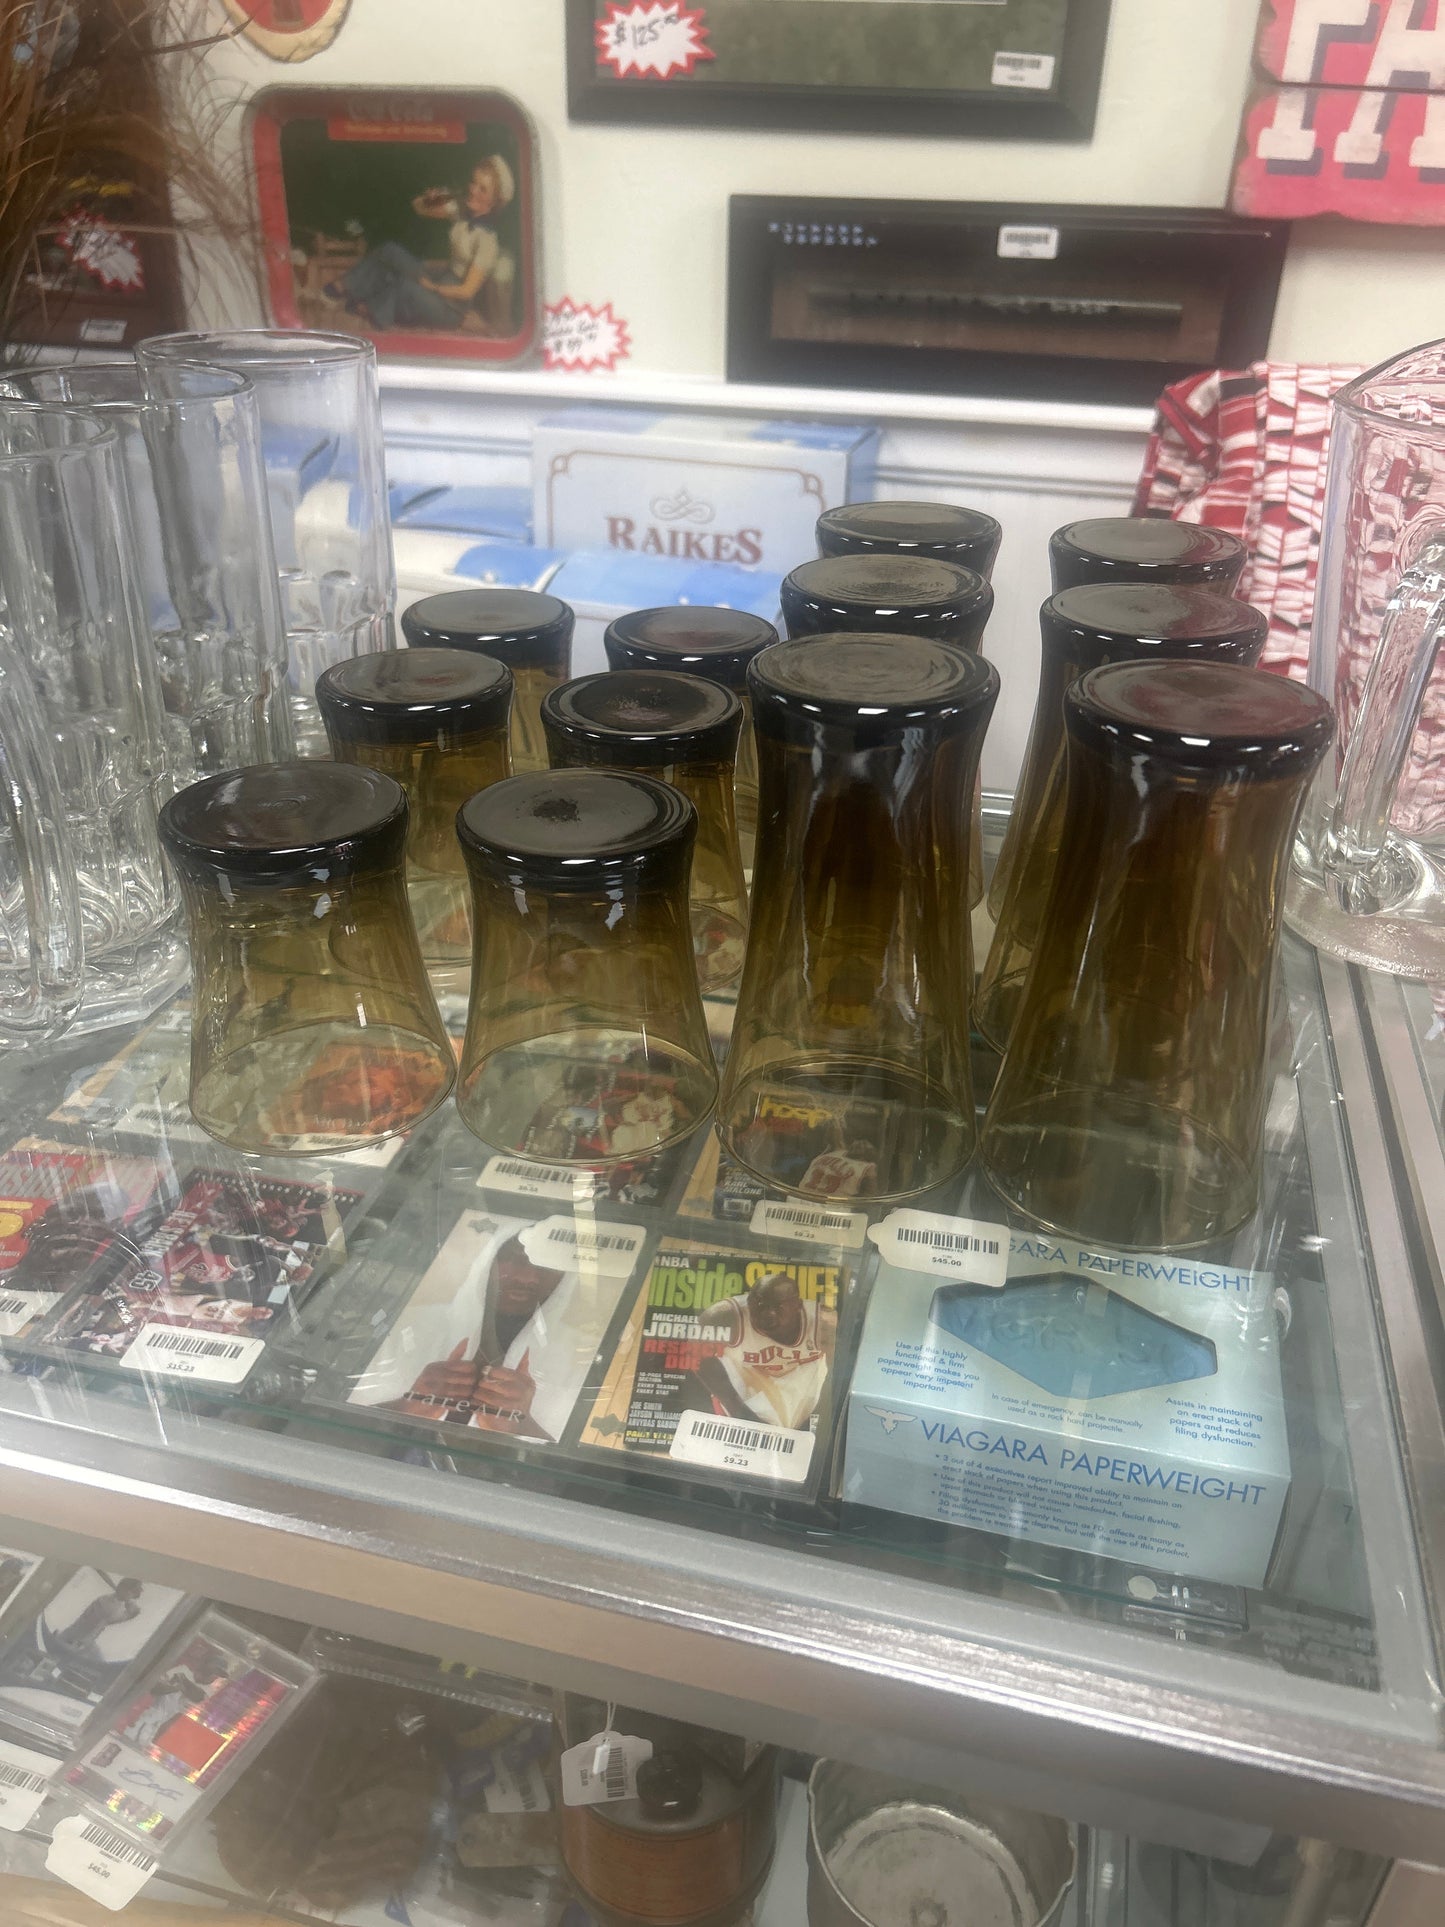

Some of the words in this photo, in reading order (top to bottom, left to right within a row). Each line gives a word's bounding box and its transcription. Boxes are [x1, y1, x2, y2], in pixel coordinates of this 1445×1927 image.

[606, 515, 764, 565] RAIKES
[722, 1187, 763, 1195] MALONE
[660, 1255, 690, 1268] NBA
[932, 1256, 962, 1267] $45.00
[1077, 1250, 1256, 1293] PAPERWEIGHT
[647, 1258, 744, 1311] inside
[652, 1312, 699, 1324] MICHAEL
[643, 1321, 731, 1342] JORDAN
[664, 1352, 700, 1370] DUE
[895, 1350, 937, 1363] functional
[948, 1359, 965, 1369] firm
[896, 1341, 912, 1350] Use
[914, 1344, 923, 1352] of
[925, 1347, 940, 1355] this
[942, 1348, 968, 1361] highly
[877, 1356, 932, 1371] paperweight
[934, 1367, 961, 1377] makes
[964, 1373, 980, 1382] you
[881, 1366, 912, 1377] appear
[915, 1373, 934, 1382] very
[903, 1379, 947, 1393] important.
[991, 1392, 999, 1401] In
[1000, 1395, 1020, 1405] case
[1022, 1398, 1030, 1407] of
[1078, 1411, 1094, 1419] can
[1095, 1413, 1106, 1421] be
[1108, 1416, 1144, 1430] manually
[1007, 1405, 1026, 1414] used
[1028, 1409, 1037, 1417] as
[1048, 1413, 1064, 1422] rock
[1066, 1416, 1085, 1426] hard
[1165, 1397, 1195, 1409] Assists
[1197, 1402, 1207, 1411] in
[1209, 1405, 1263, 1423] maintaining
[1191, 1412, 1214, 1421] erect
[1217, 1415, 1241, 1426] stack
[1243, 1420, 1252, 1429] of
[1169, 1417, 1201, 1428] papers
[1203, 1423, 1223, 1432] and
[1225, 1427, 1261, 1440] reduces
[1175, 1425, 1198, 1439] filing
[1200, 1431, 1256, 1448] dysfunction.
[723, 1456, 749, 1467] $9.23
[920, 1419, 1049, 1466] VIAGARA
[1060, 1449, 1266, 1506] PAPERWEIGHT
[943, 1454, 949, 1462] 3
[951, 1457, 964, 1466] out
[966, 1459, 976, 1468] of
[984, 1465, 1025, 1480] executives
[1027, 1474, 1052, 1485] report
[1054, 1479, 1093, 1494] improved
[1094, 1487, 1120, 1500] ability
[1133, 1495, 1169, 1507] maintain
[964, 1468, 984, 1479] stack
[986, 1473, 995, 1481] of
[996, 1476, 1024, 1489] papers
[1026, 1482, 1048, 1493] when
[1050, 1488, 1072, 1499] using
[1074, 1492, 1089, 1501] this
[940, 1473, 955, 1482] Use
[957, 1476, 966, 1484] of
[968, 1479, 981, 1489] this
[983, 1482, 1014, 1495] product
[1016, 1489, 1030, 1499] will
[1032, 1493, 1045, 1502] not
[1047, 1498, 1071, 1508] cause
[1073, 1500, 1119, 1518] headaches,
[1121, 1511, 1145, 1522] facial
[963, 1486, 995, 1499] stomach
[938, 1490, 960, 1502] Filing
[1009, 1507, 1050, 1522] commonly
[1052, 1515, 1079, 1528] known
[1081, 1522, 1091, 1530] as
[1109, 1527, 1136, 1539] affects
[1138, 1533, 1147, 1541] as
[1150, 1536, 1173, 1547] many
[1175, 1541, 1185, 1549] as
[938, 1499, 950, 1507] 30
[980, 1507, 997, 1516] men
[1064, 1525, 1078, 1535] but
[1080, 1530, 1096, 1540] with
[1098, 1534, 1112, 1543] the
[1113, 1537, 1128, 1546] use
[1129, 1539, 1139, 1548] of
[1140, 1541, 1154, 1551] this
[1156, 1545, 1190, 1559] product,
